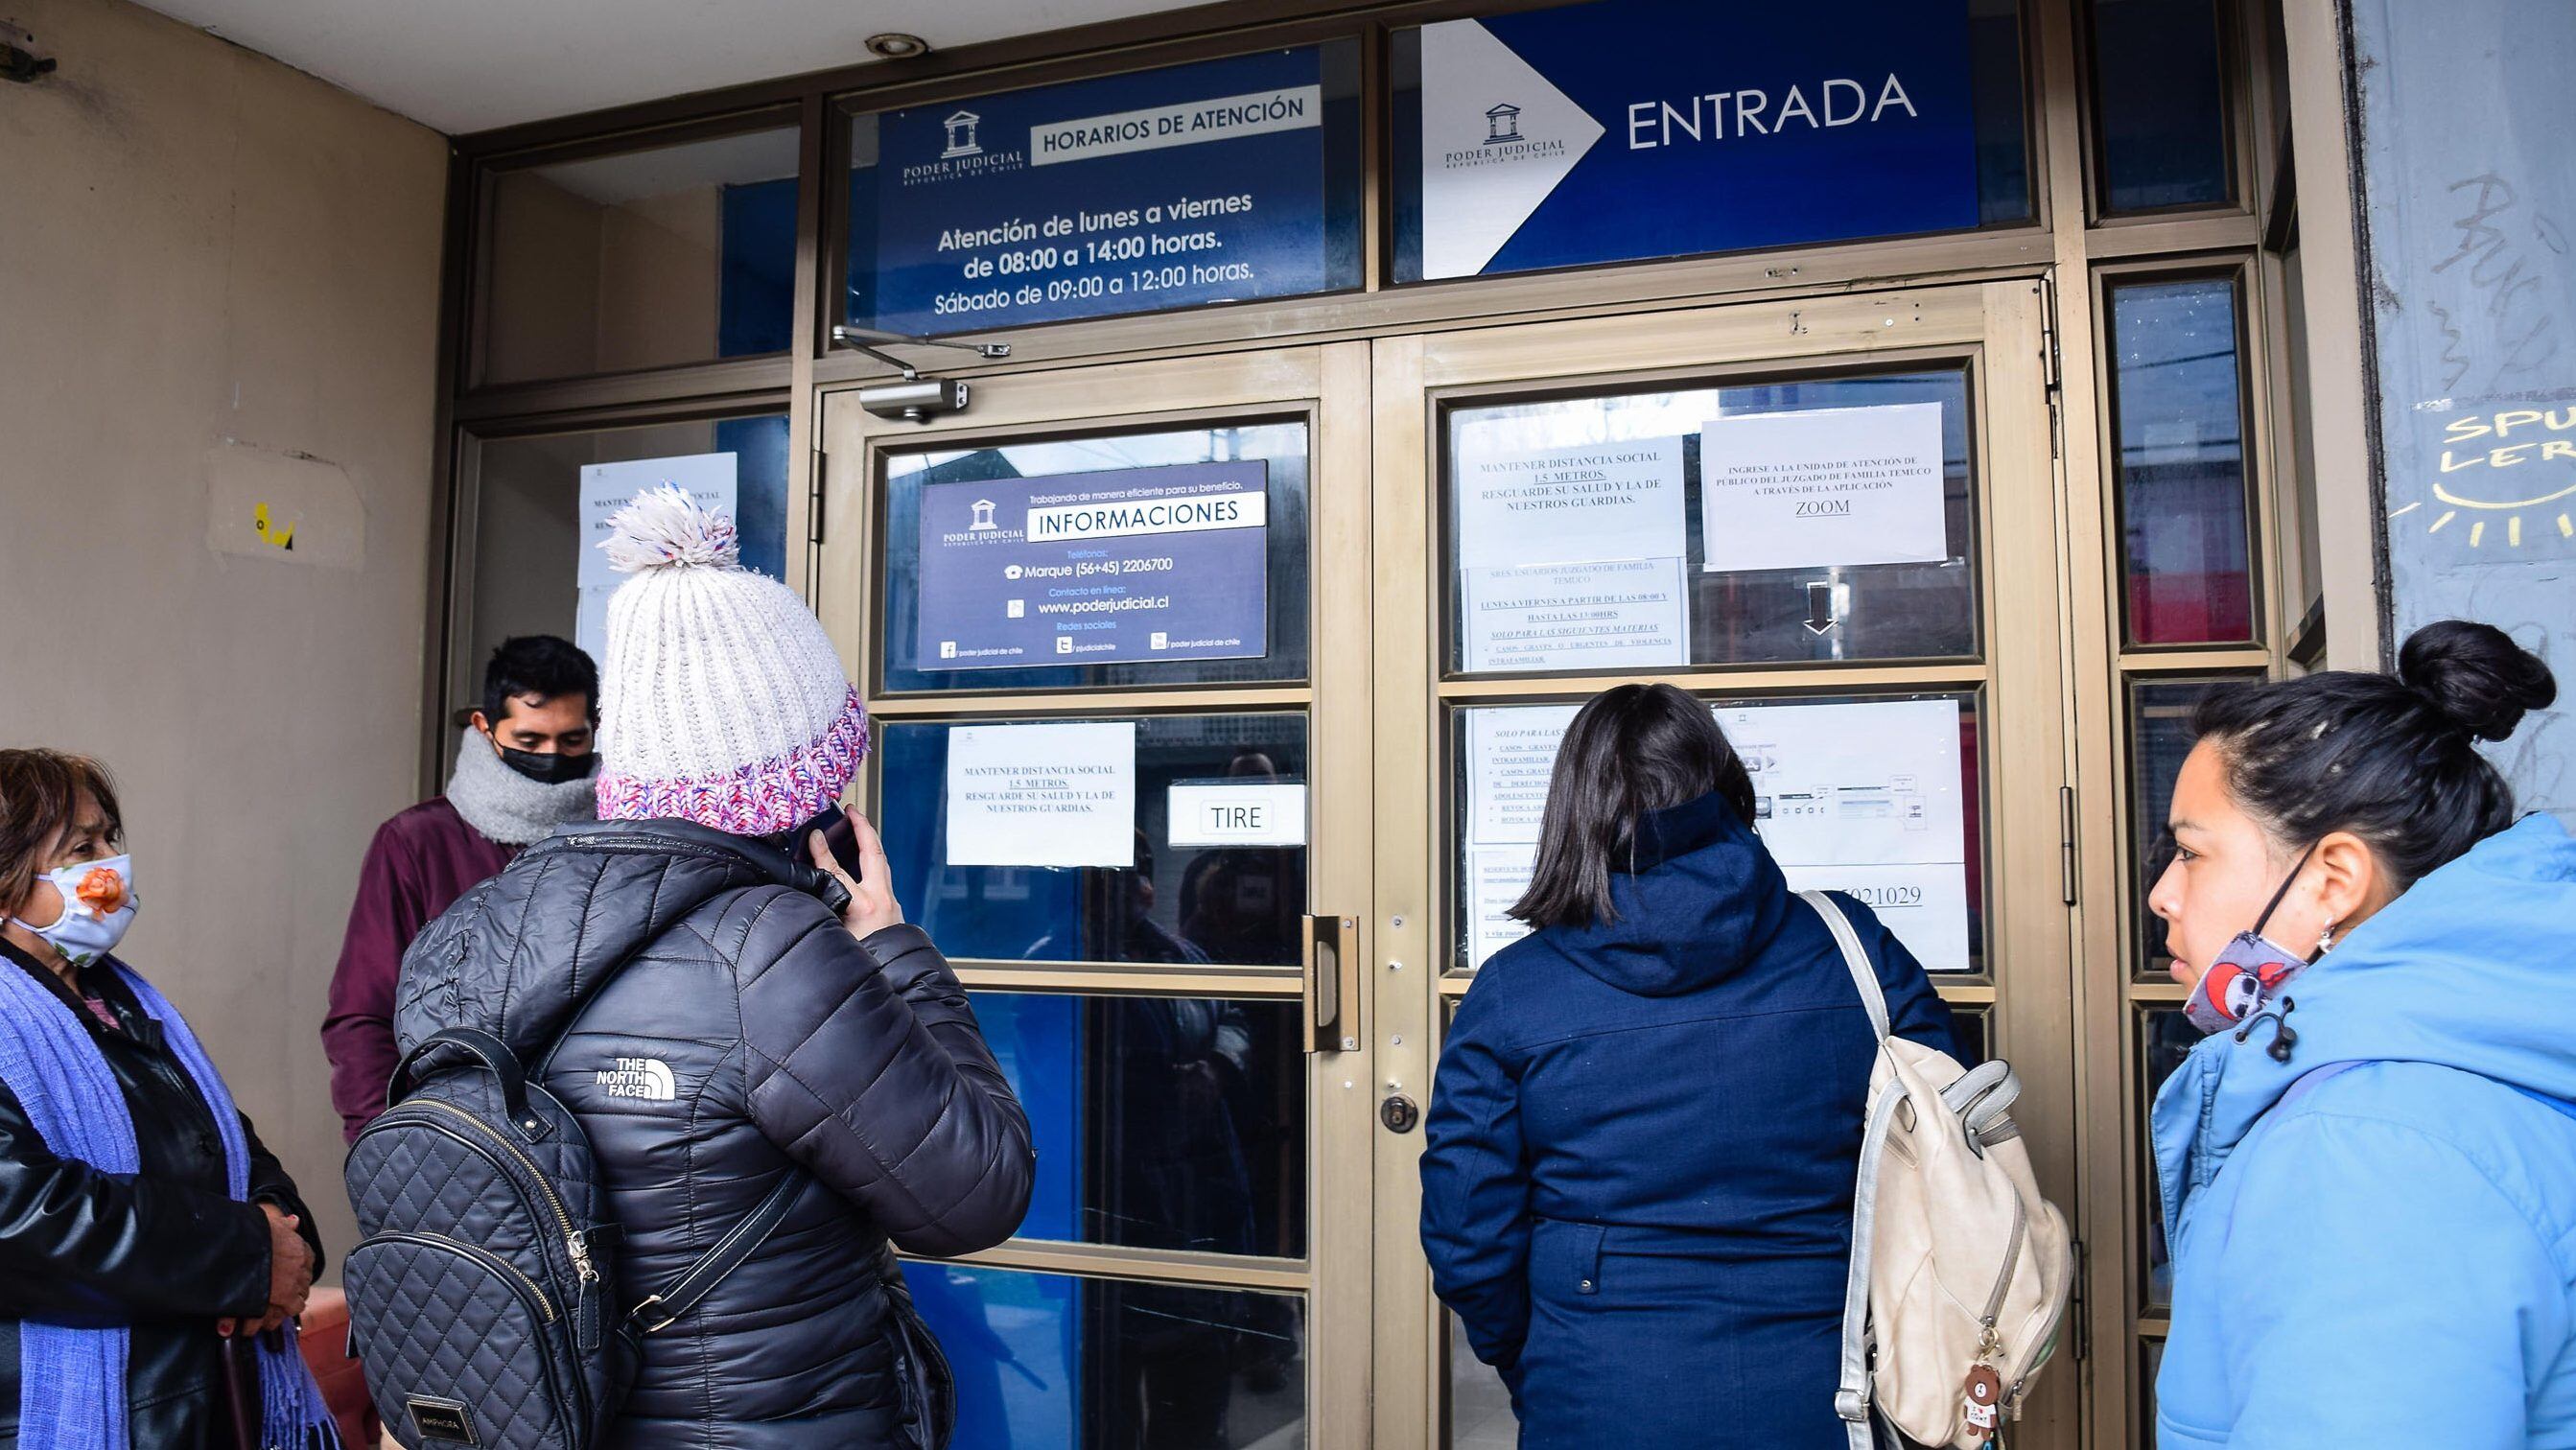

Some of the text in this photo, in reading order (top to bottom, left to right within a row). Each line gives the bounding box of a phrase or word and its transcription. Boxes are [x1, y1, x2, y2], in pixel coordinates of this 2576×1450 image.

[1628, 73, 1917, 150] ENTRADA
[1043, 96, 1303, 152] HORARIOS DE ATENCIÓN
[1446, 140, 1564, 162] PODER JUDICIAL
[903, 151, 1023, 178] PODER JUDICIAL
[992, 163, 1023, 174] CHILE
[938, 192, 1253, 252] Atención de lunes a viernes
[964, 228, 1222, 279] de 08:00 a 14:00 horas.
[934, 259, 1254, 316] Sábado de 09:00 a 12:00 horas.
[1481, 452, 1661, 474] MANTENER DISTANCIA SOCIAL
[1728, 465, 1769, 475] INGRESE
[1797, 462, 1834, 471] UNIDAD
[1837, 460, 1850, 469] DE
[1853, 457, 1902, 468] ATENCIÓN
[1905, 456, 1917, 465] DE
[1534, 469, 1606, 483] 1.5 METROS.
[1717, 477, 1758, 487] PÚBLICO
[1760, 476, 1779, 484] DEL
[1781, 474, 1827, 483] JUZGADO
[1845, 470, 1885, 479] FAMILIA
[1889, 467, 1932, 478] TEMUCO
[1030, 494, 1076, 505] Trabajando
[1092, 491, 1125, 500] manera
[1127, 486, 1163, 498] eficiente
[1165, 486, 1186, 496] para
[1199, 480, 1243, 492] beneficio.
[1482, 479, 1661, 500] RESGUARDE SU SALUD Y LA DE
[1762, 485, 1800, 495] TRAVÉS
[1817, 484, 1830, 493] LA
[1832, 480, 1893, 492] APLICACIÓN
[1507, 495, 1635, 511] NUESTROS GUARDIAS.
[1795, 499, 1850, 516] ZOOM
[1040, 501, 1238, 534] INFORMACIONES
[944, 530, 1024, 542] PODER JUDICIAL
[1025, 558, 1173, 578] Marque (56+45) 2206700
[1560, 564, 1602, 574] JUZGADO
[1604, 564, 1615, 573] DE
[1617, 562, 1654, 571] FAMILIA
[1554, 575, 1591, 585] TEMUCO
[1048, 587, 1089, 597] Contacto
[1103, 585, 1126, 595] línea:
[1039, 596, 1169, 615] www.poderjudicial.cl
[1481, 600, 1509, 609] LUNES
[1518, 598, 1557, 607] VIERNES
[1568, 596, 1602, 604] PARTIR
[1604, 595, 1614, 603] DE
[1619, 594, 1636, 602] LAS
[1528, 613, 1557, 621] HASTA
[1560, 612, 1577, 620] LAS
[1057, 620, 1116, 631] Redes sociales
[1491, 630, 1513, 639] SOLO
[1515, 629, 1538, 638] PARA
[1557, 625, 1610, 635] SIGUIENTES
[1614, 624, 1658, 633] MATERIAS
[1008, 646, 1023, 655] chile
[1190, 639, 1213, 648] judicial
[965, 765, 1115, 776] MANTENER DISTANCIA SOCIAL
[1025, 779, 1069, 787] METROS.
[966, 792, 1022, 801] RESGUARDE
[1026, 791, 1039, 800] SU
[1041, 791, 1073, 800] SALUD
[987, 804, 1093, 813] NUESTROS GUARDIAS.
[1211, 807, 1261, 829] TIRE
[1841, 886, 1922, 905] 021029
[616, 1057, 645, 1071] THE
[597, 1070, 644, 1086] NORTH
[608, 1085, 644, 1097] FACE
